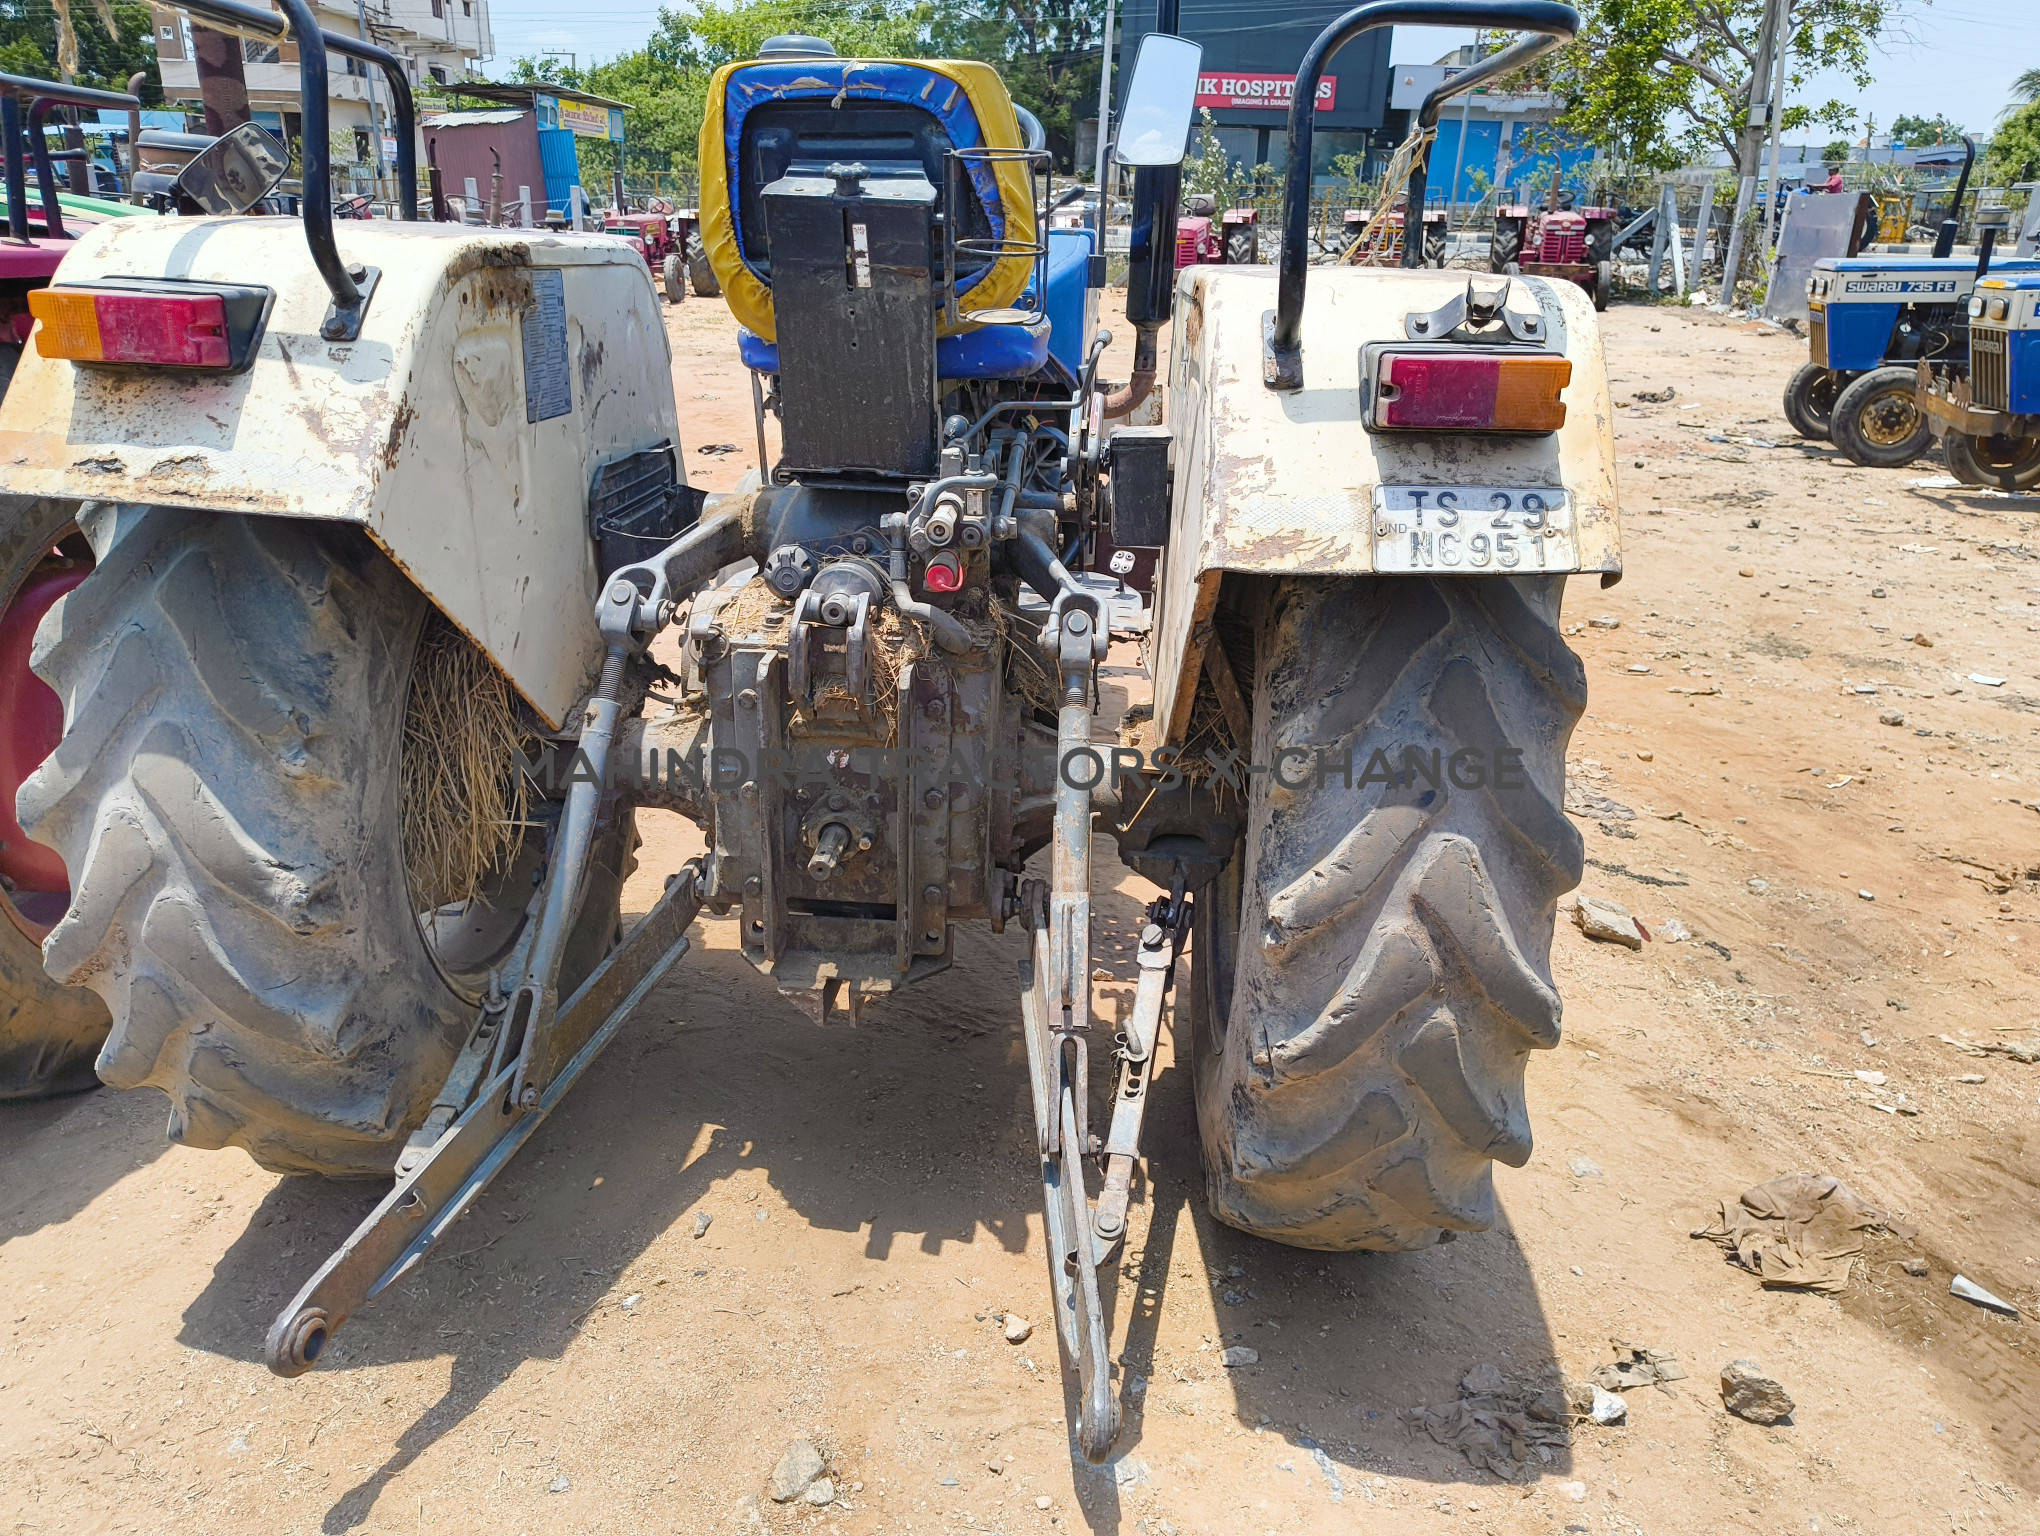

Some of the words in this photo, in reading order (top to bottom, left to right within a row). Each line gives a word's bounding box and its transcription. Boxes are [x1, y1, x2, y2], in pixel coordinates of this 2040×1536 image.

[1220, 79, 1332, 99] HOSPITS
[1906, 281, 1934, 292] 735
[1936, 281, 1954, 292] FE
[1407, 490, 1460, 528] TS
[1489, 491, 1547, 530] 29
[1409, 530, 1546, 568] N6951
